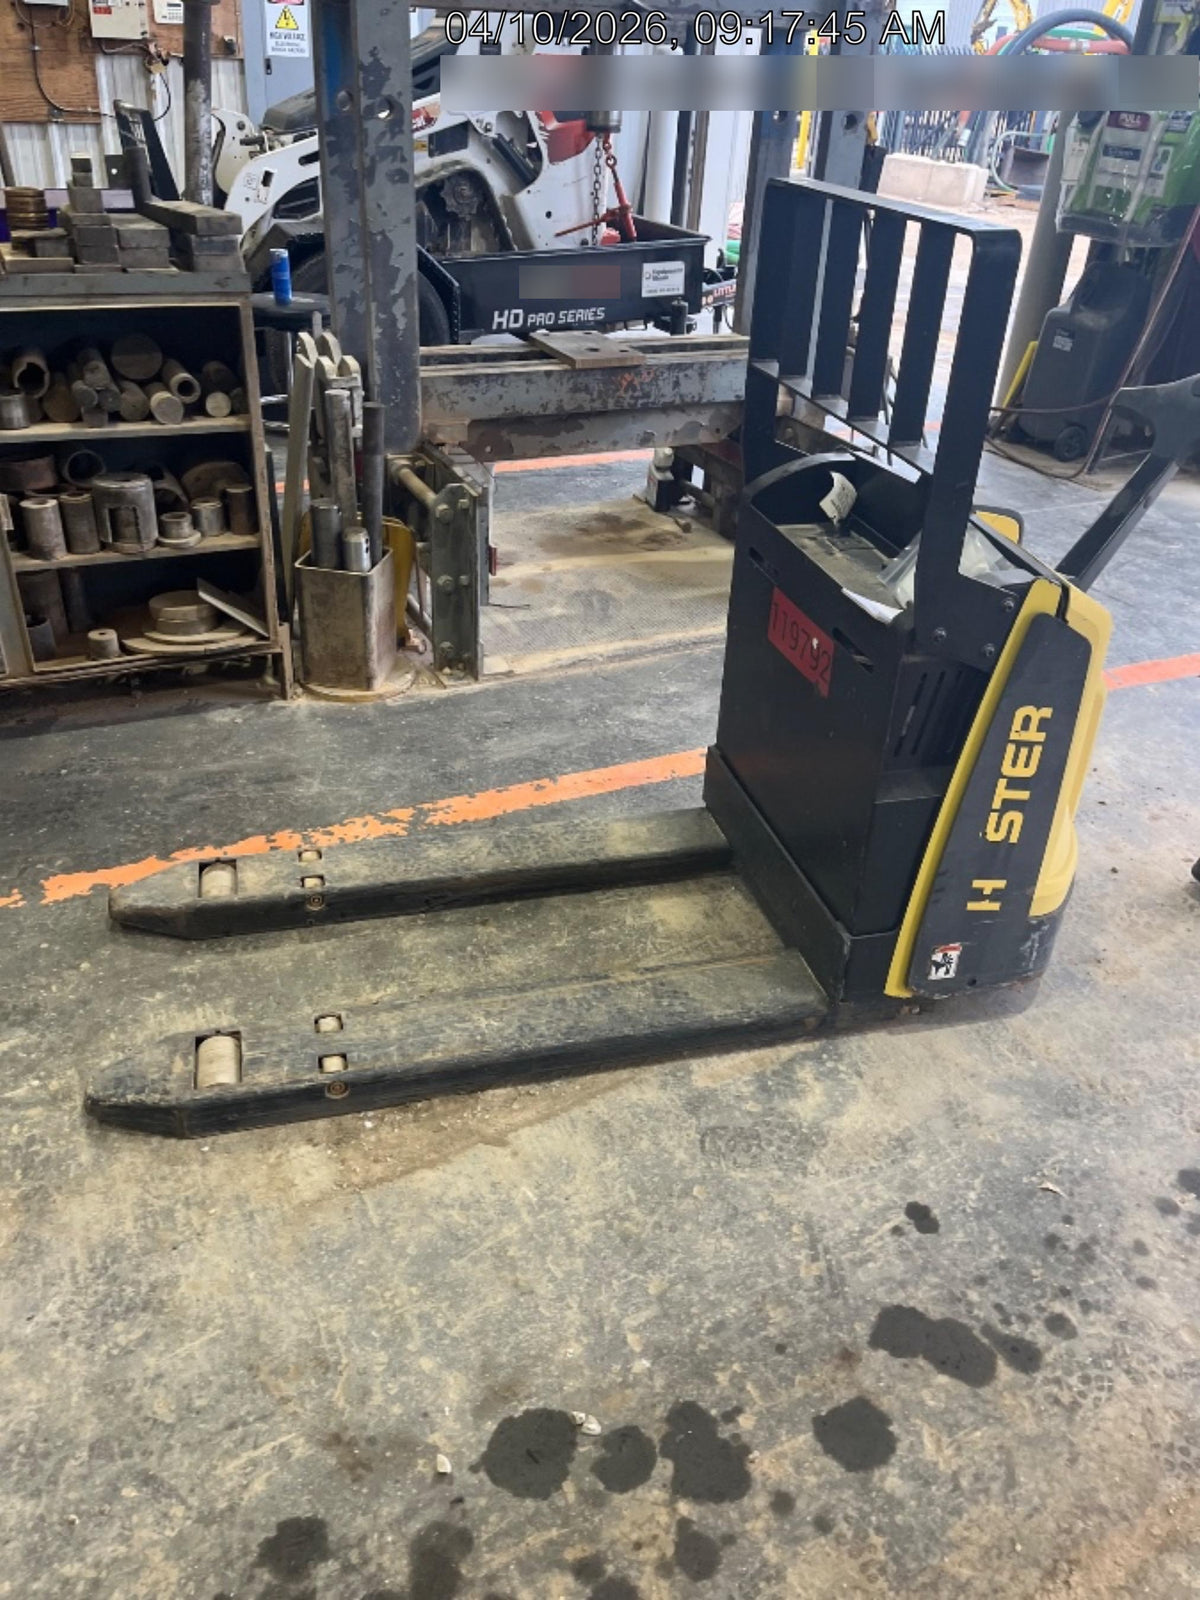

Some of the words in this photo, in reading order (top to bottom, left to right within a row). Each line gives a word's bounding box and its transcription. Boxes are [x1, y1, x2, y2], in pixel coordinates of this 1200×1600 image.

[492, 308, 524, 330] HD
[527, 312, 556, 328] PRO
[557, 306, 606, 324] SERIES
[966, 705, 1053, 911] HSTER
